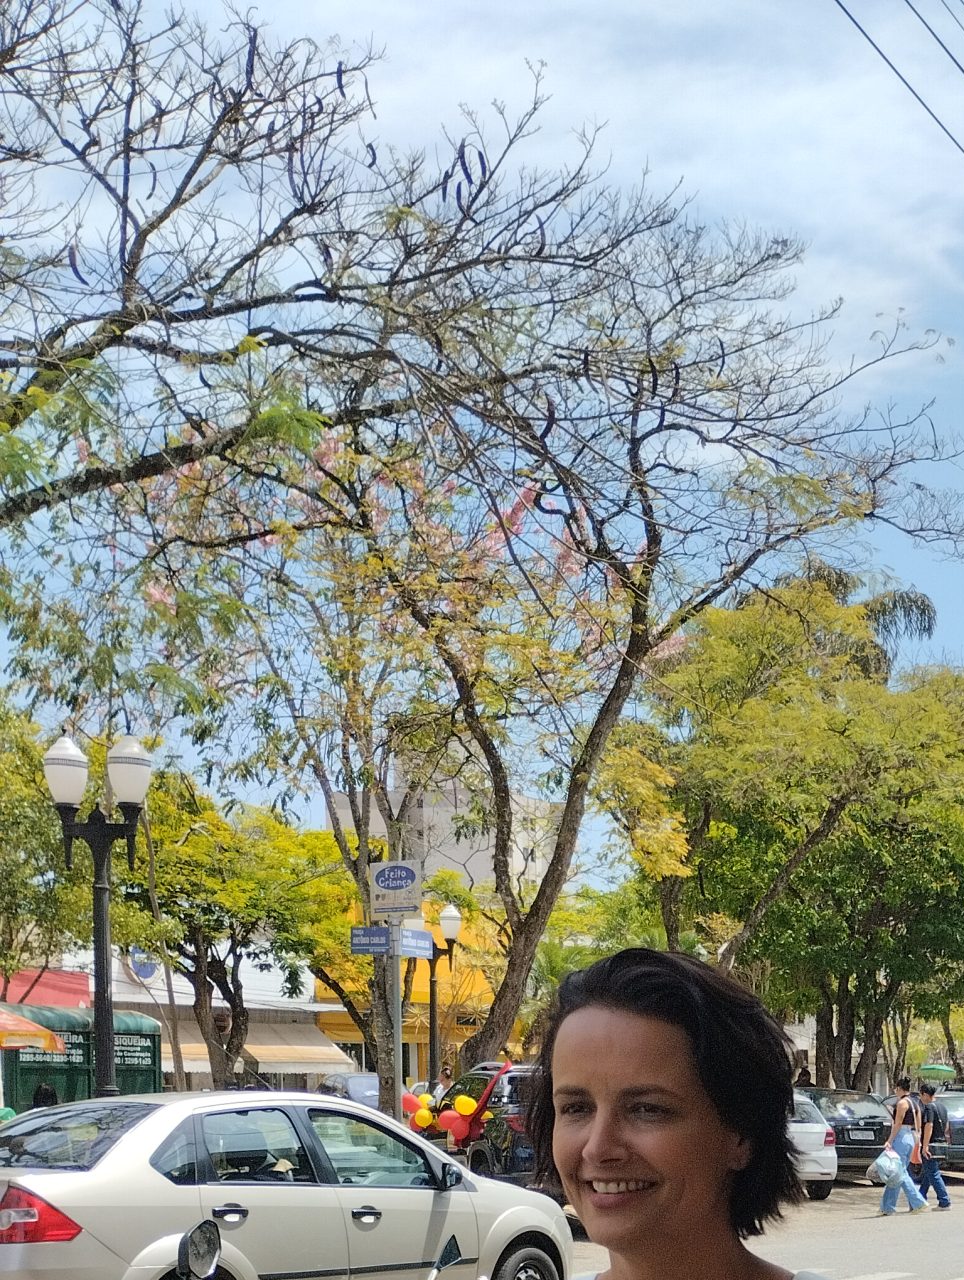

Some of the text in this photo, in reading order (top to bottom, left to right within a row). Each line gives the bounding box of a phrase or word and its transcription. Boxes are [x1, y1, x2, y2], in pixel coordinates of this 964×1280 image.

[385, 868, 407, 879] Feito
[378, 878, 412, 889] Criança
[114, 1037, 152, 1047] SIQUEIRA
